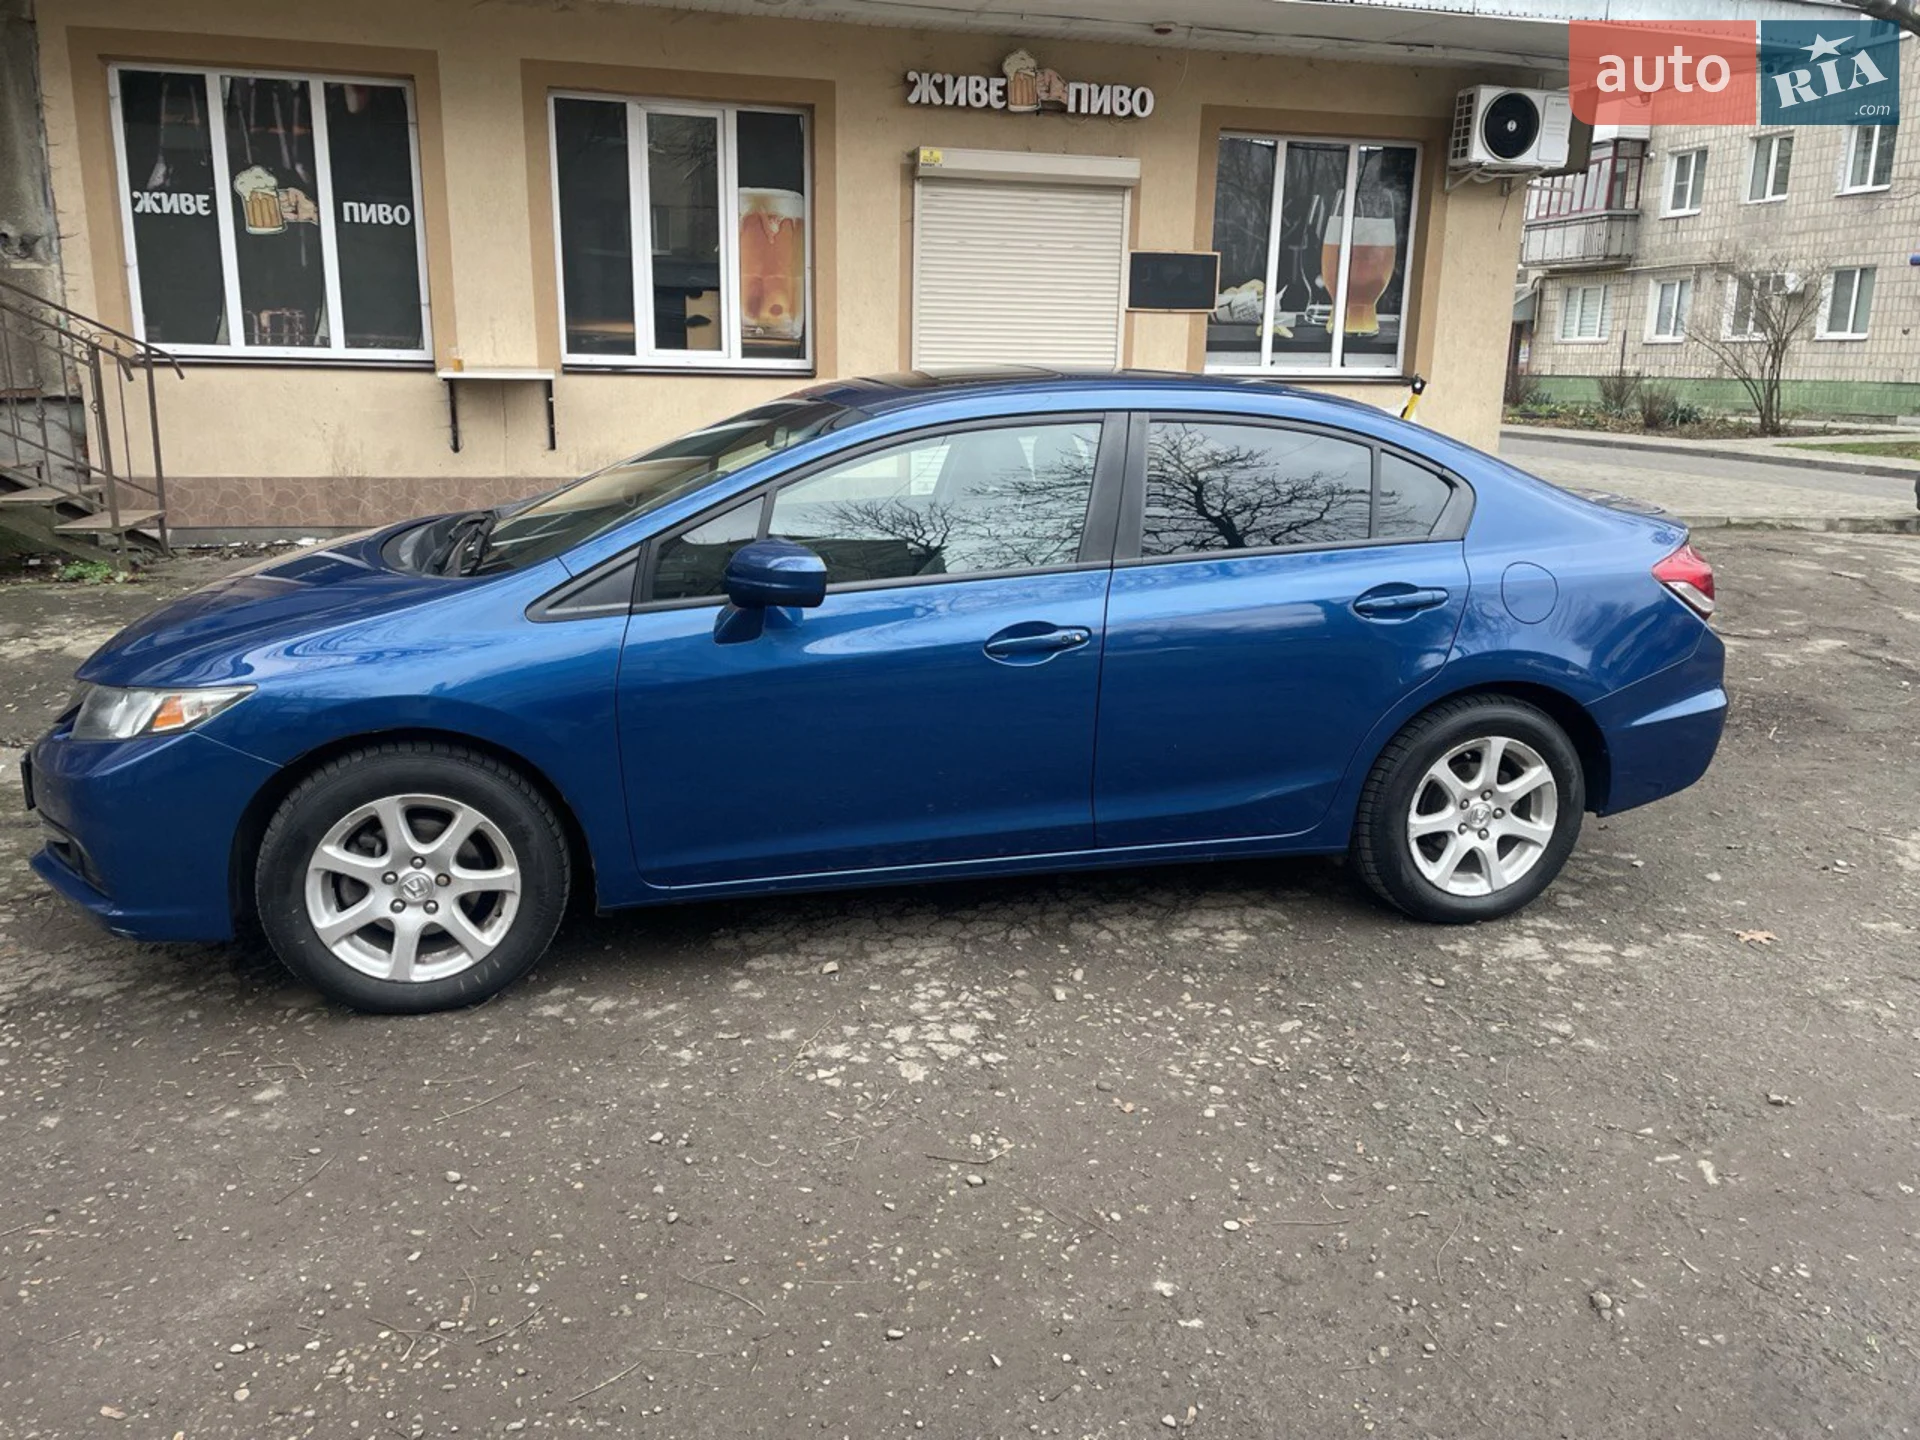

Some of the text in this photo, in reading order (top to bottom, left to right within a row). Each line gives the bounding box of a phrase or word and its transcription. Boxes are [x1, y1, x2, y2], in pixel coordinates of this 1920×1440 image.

[907, 70, 1155, 118] ЖИВЕ ПИВО
[132, 191, 411, 225] ЖИВЕ ПИВО
